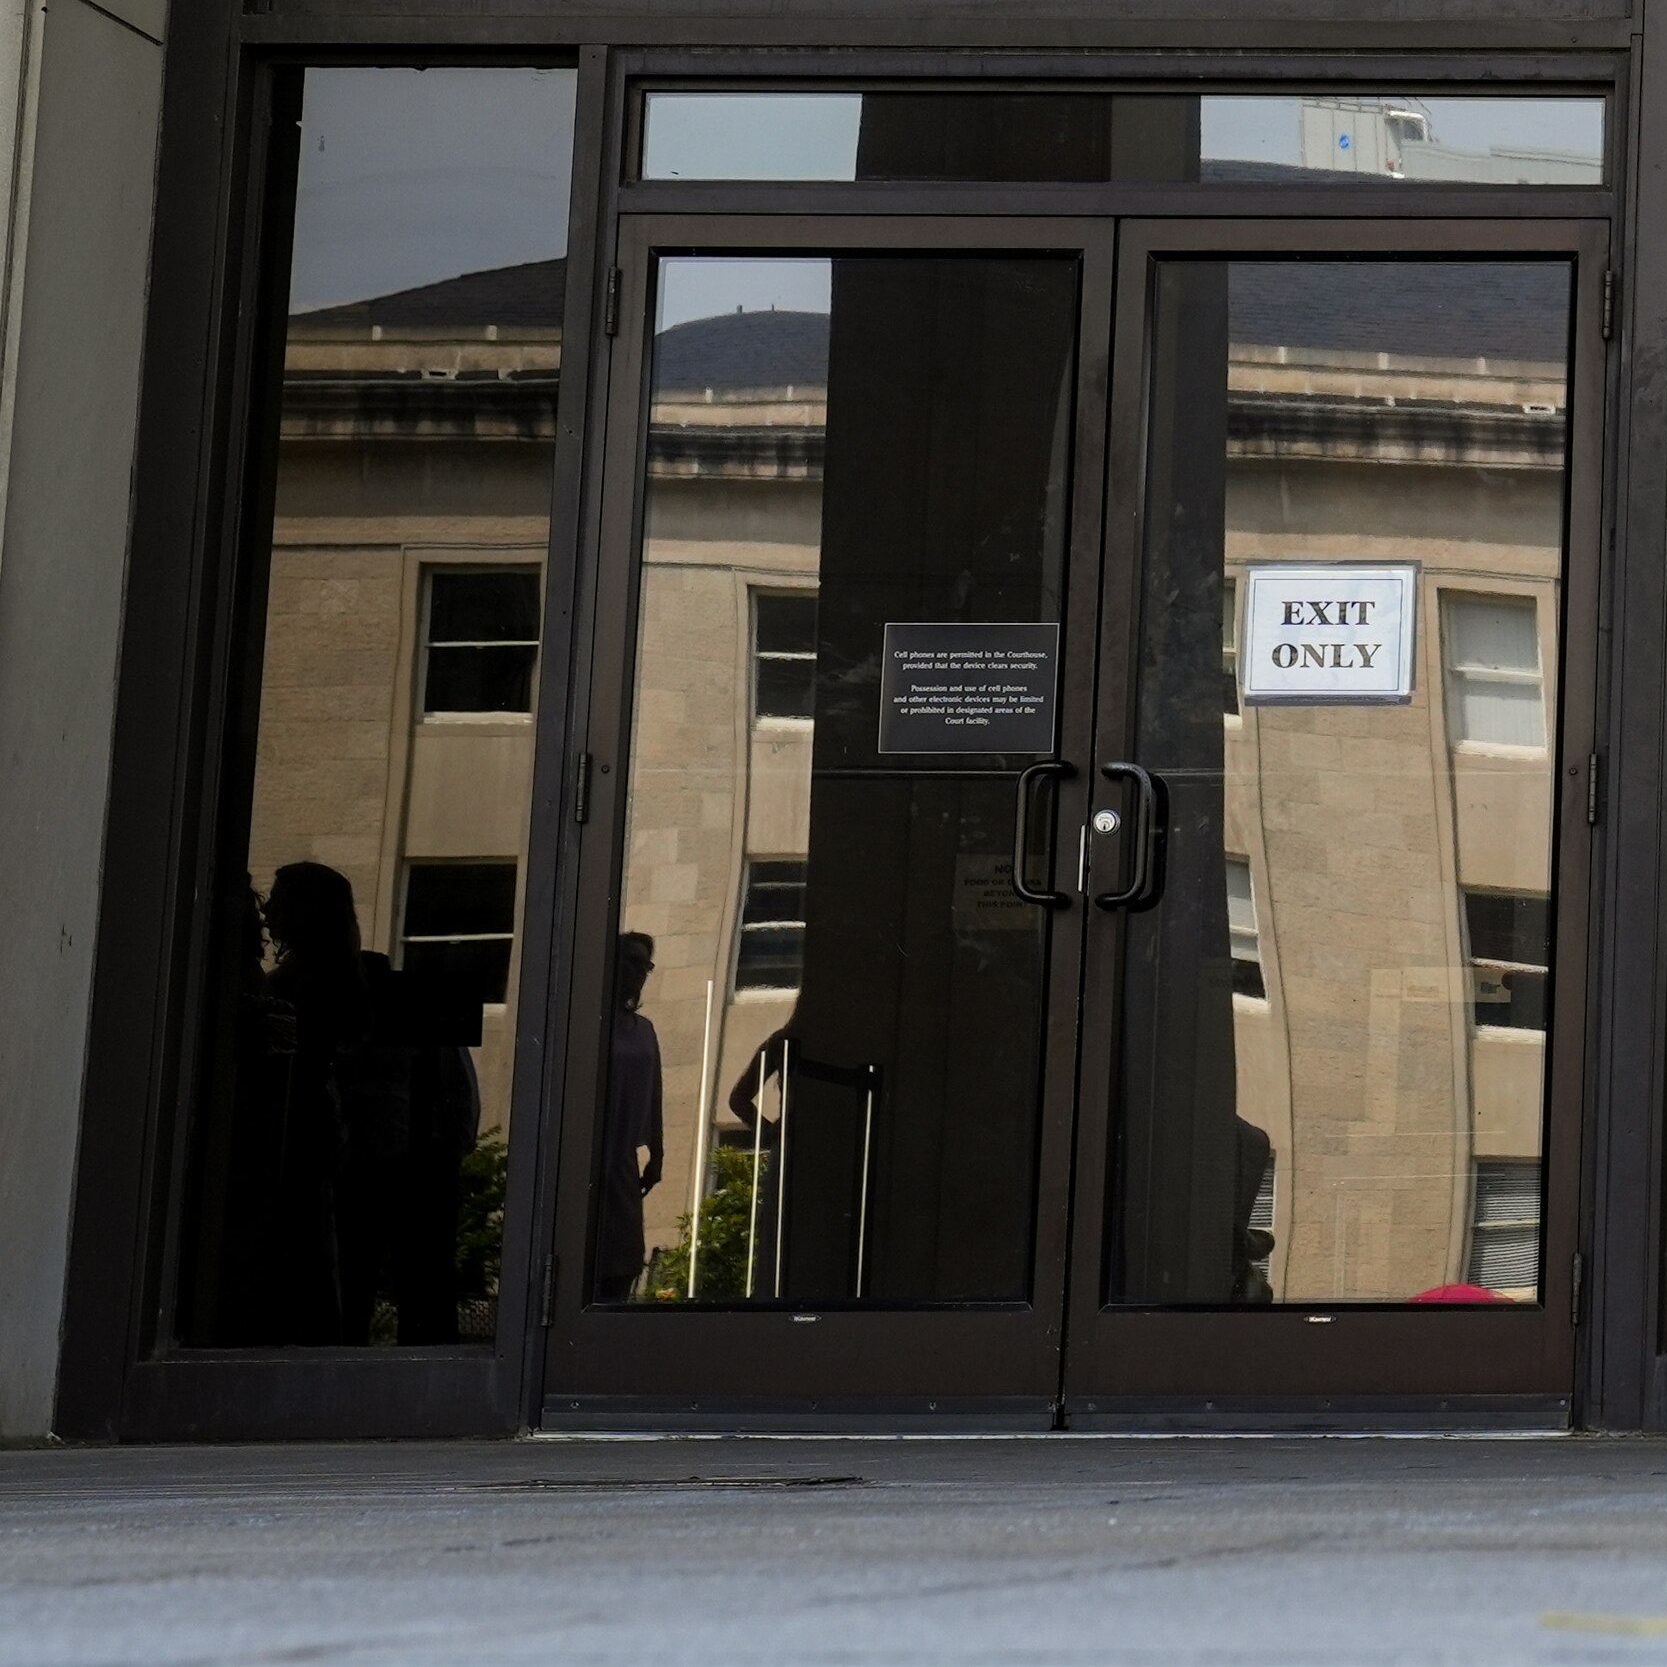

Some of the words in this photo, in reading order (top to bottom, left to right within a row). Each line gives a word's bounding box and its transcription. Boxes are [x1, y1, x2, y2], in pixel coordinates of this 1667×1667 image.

[1281, 601, 1376, 625] EXIT
[909, 651, 935, 659] phones
[950, 651, 983, 659] permitted
[1271, 643, 1382, 668] ONLY
[902, 662, 933, 670] provided
[910, 706, 945, 714] prohibited
[955, 706, 993, 714] designated
[1015, 706, 1023, 714] of
